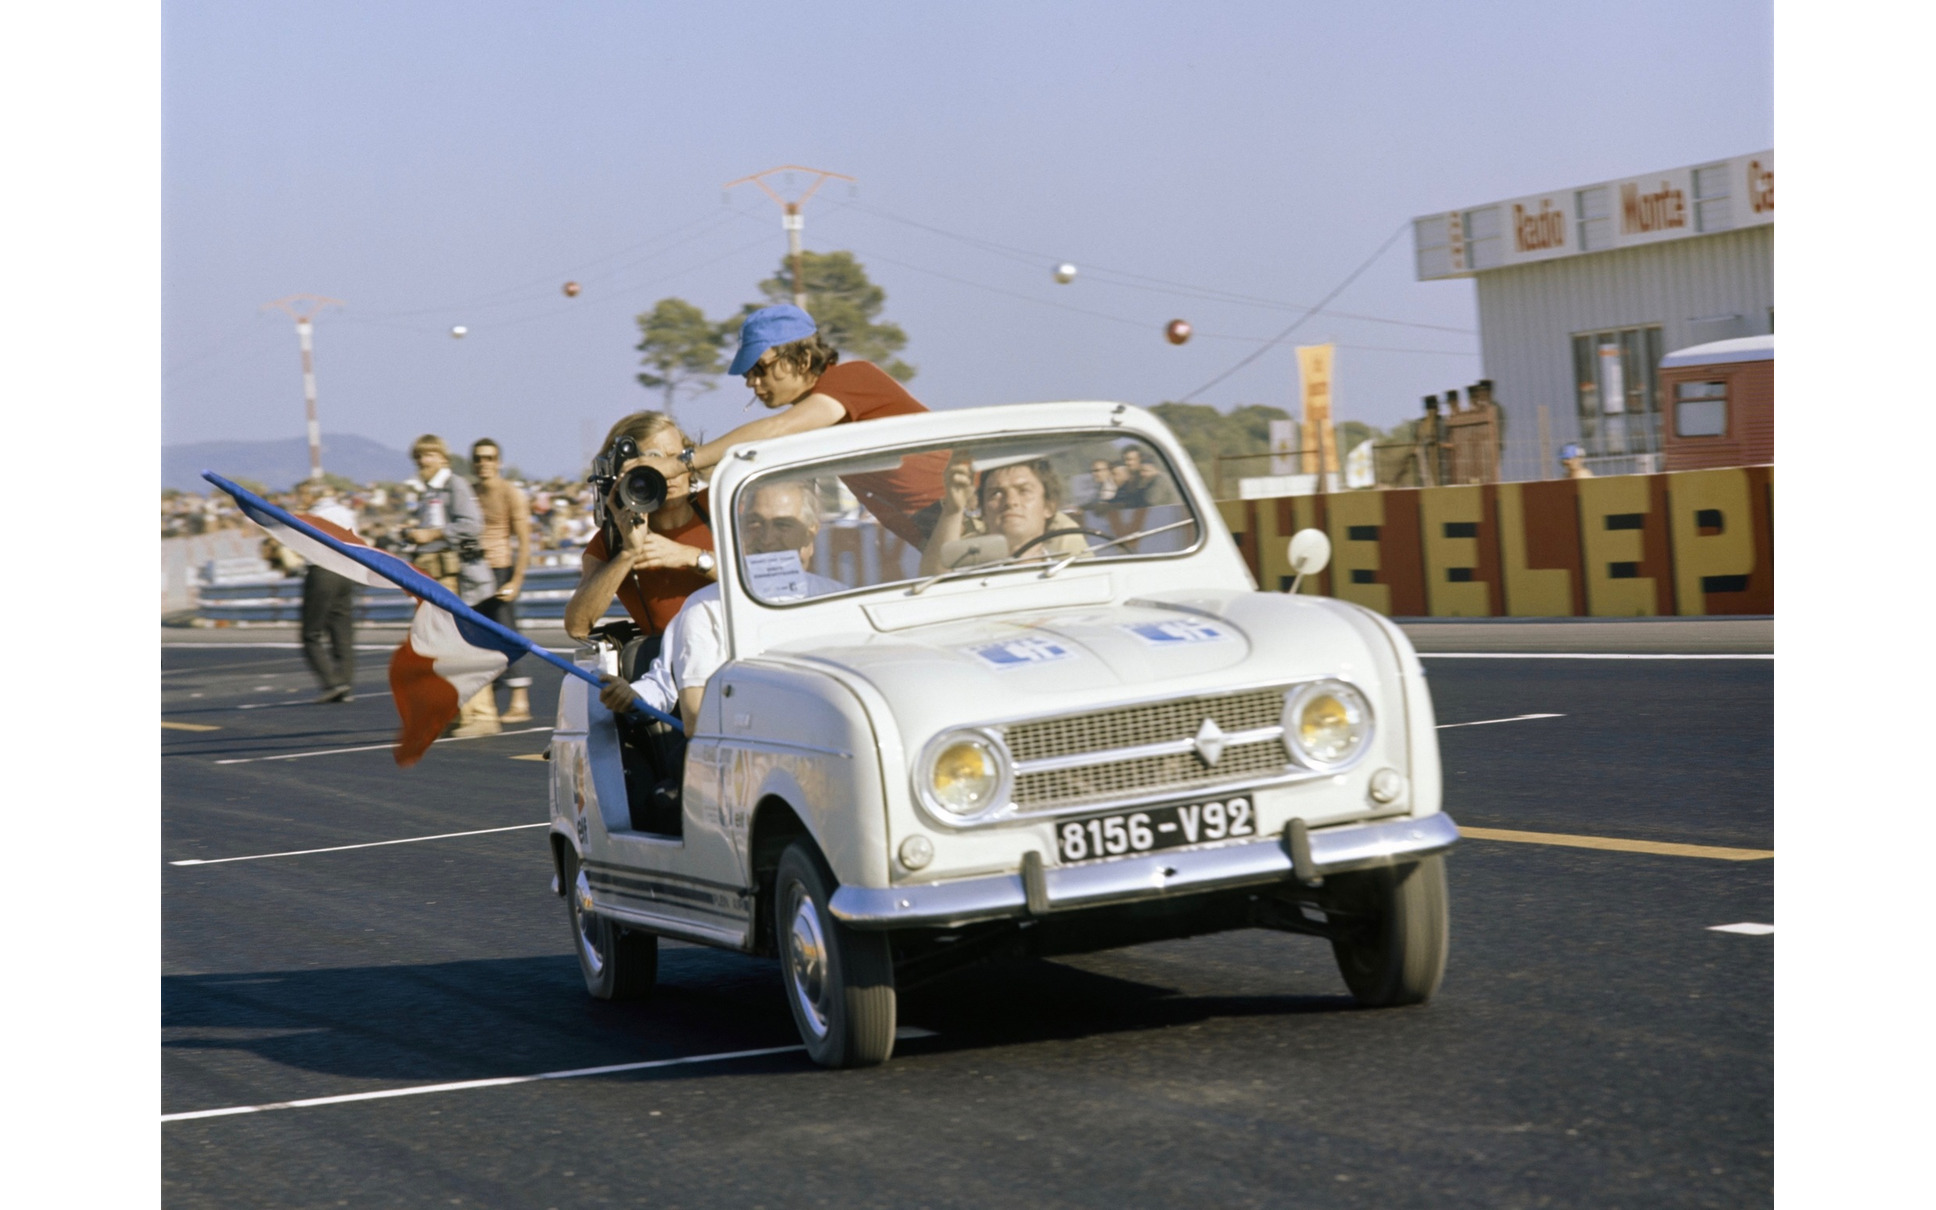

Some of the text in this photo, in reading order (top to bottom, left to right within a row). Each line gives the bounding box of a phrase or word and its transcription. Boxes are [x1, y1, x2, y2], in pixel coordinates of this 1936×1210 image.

[1512, 199, 1565, 252] Radio
[1620, 180, 1686, 235] Monte
[1062, 797, 1253, 860] 8156-V92
